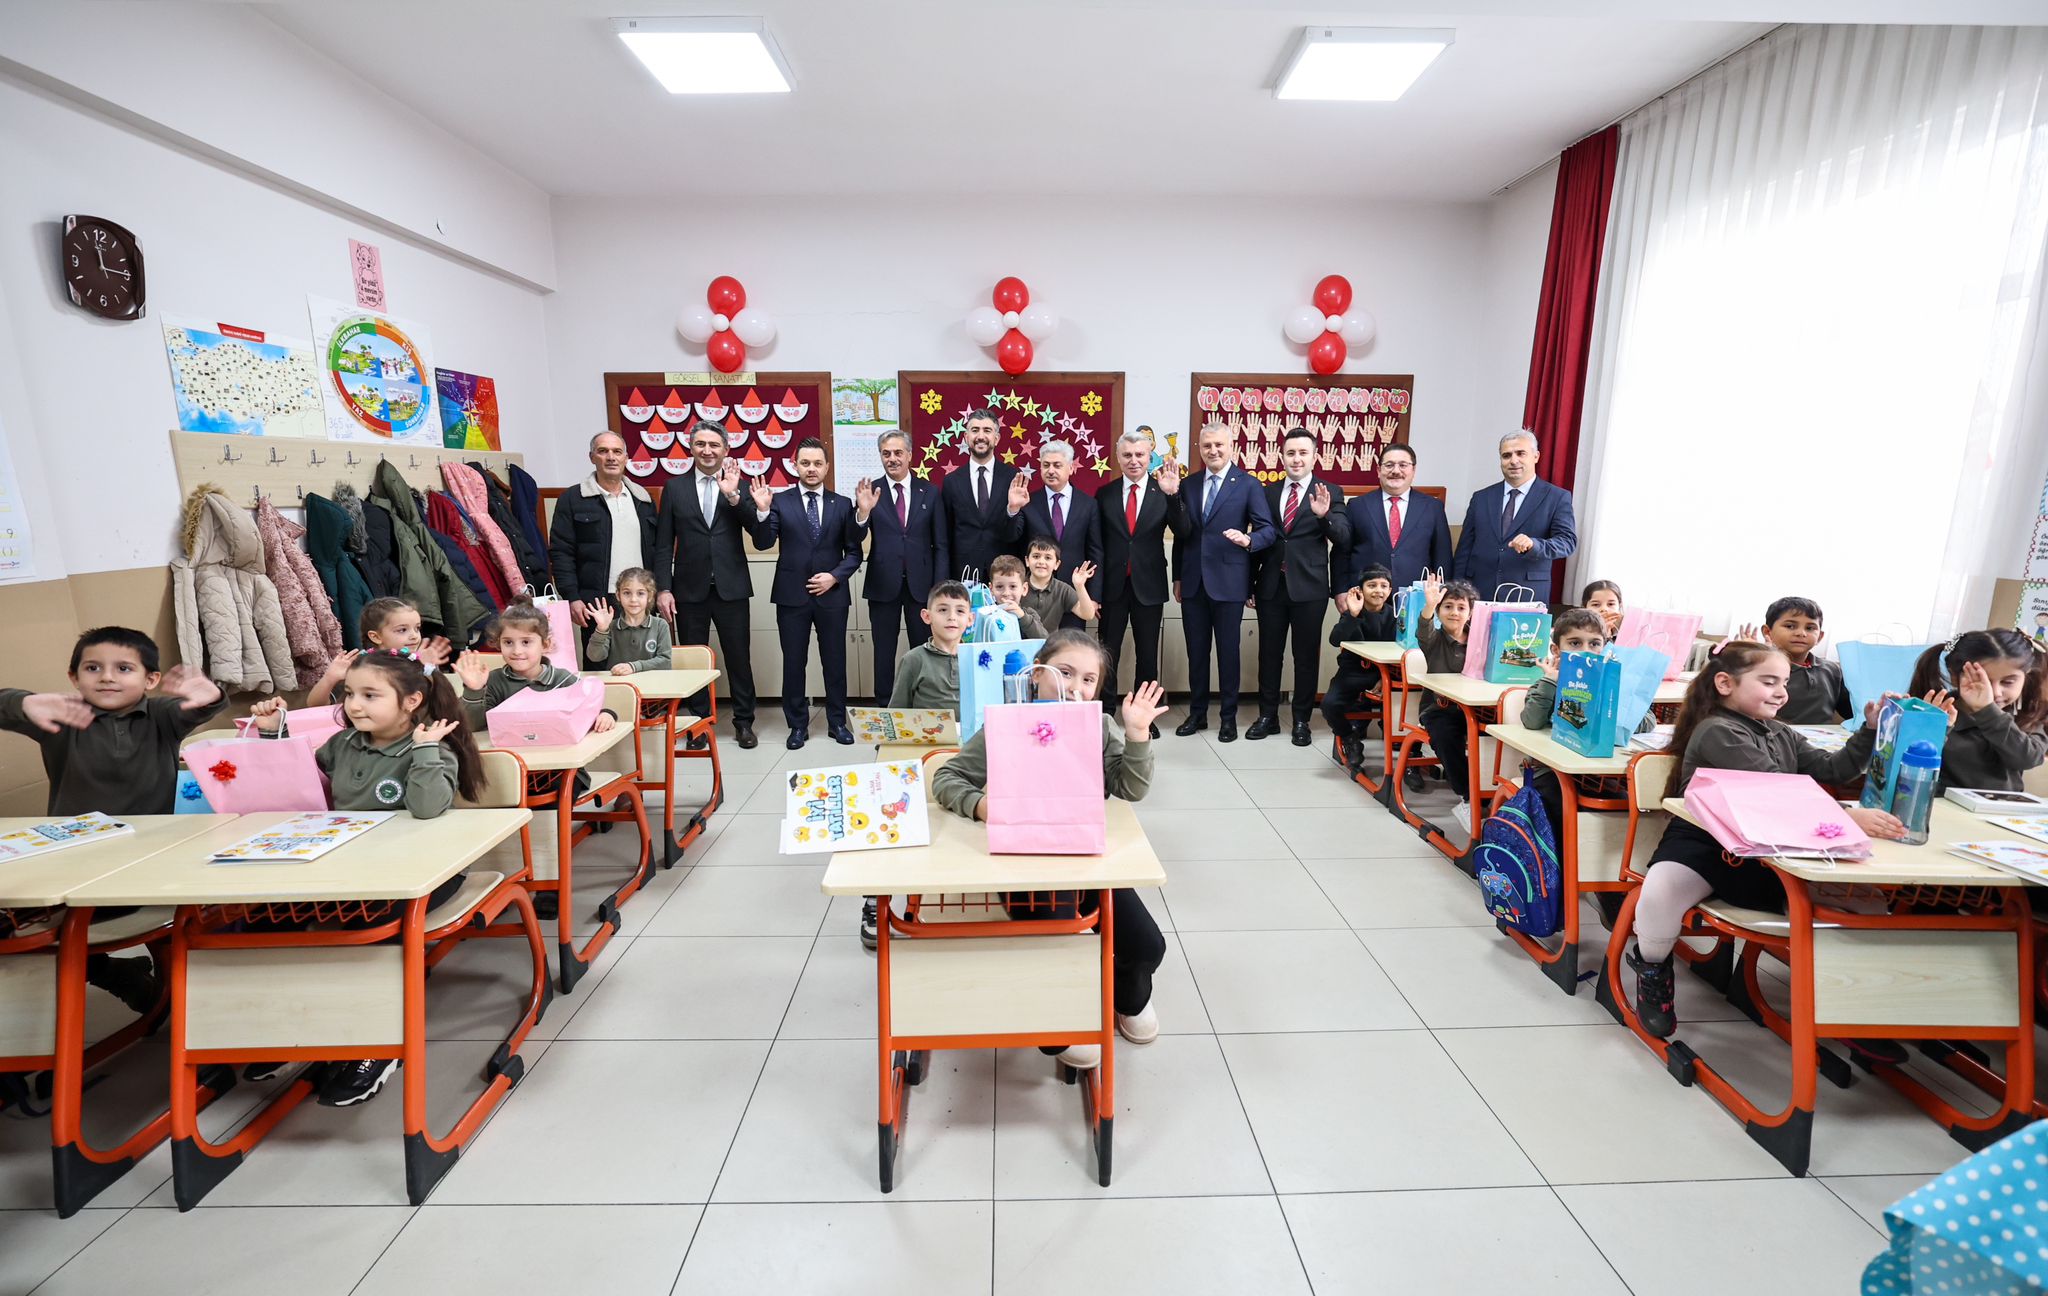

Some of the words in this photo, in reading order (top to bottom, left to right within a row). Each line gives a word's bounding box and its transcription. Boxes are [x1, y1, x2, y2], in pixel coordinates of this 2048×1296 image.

[93, 228, 107, 244] 12
[71, 254, 80, 268] 9
[122, 269, 132, 281] 3
[99, 294, 108, 307] 6
[336, 325, 362, 348] İLKBAHAR
[673, 373, 703, 383] GÖRSEL
[713, 374, 755, 384] SANATLAR
[1204, 394, 1214, 405] 10
[1223, 395, 1236, 406] 20
[1245, 395, 1257, 406] 30
[1265, 394, 1280, 404] 40
[1287, 395, 1300, 406] 50
[1309, 395, 1321, 407] 60
[1331, 396, 1342, 407] 70
[1350, 395, 1363, 406] 80
[1373, 395, 1385, 406] 90
[1391, 395, 1405, 404] 100
[351, 402, 365, 418] YAZ
[990, 395, 1105, 470] OKUYORUZ
[1363, 426, 1375, 436] 45
[1382, 427, 1394, 436] 50
[1342, 455, 1353, 464] 90
[805, 800, 826, 822] İYİ
[827, 774, 845, 841] TATİLLER
